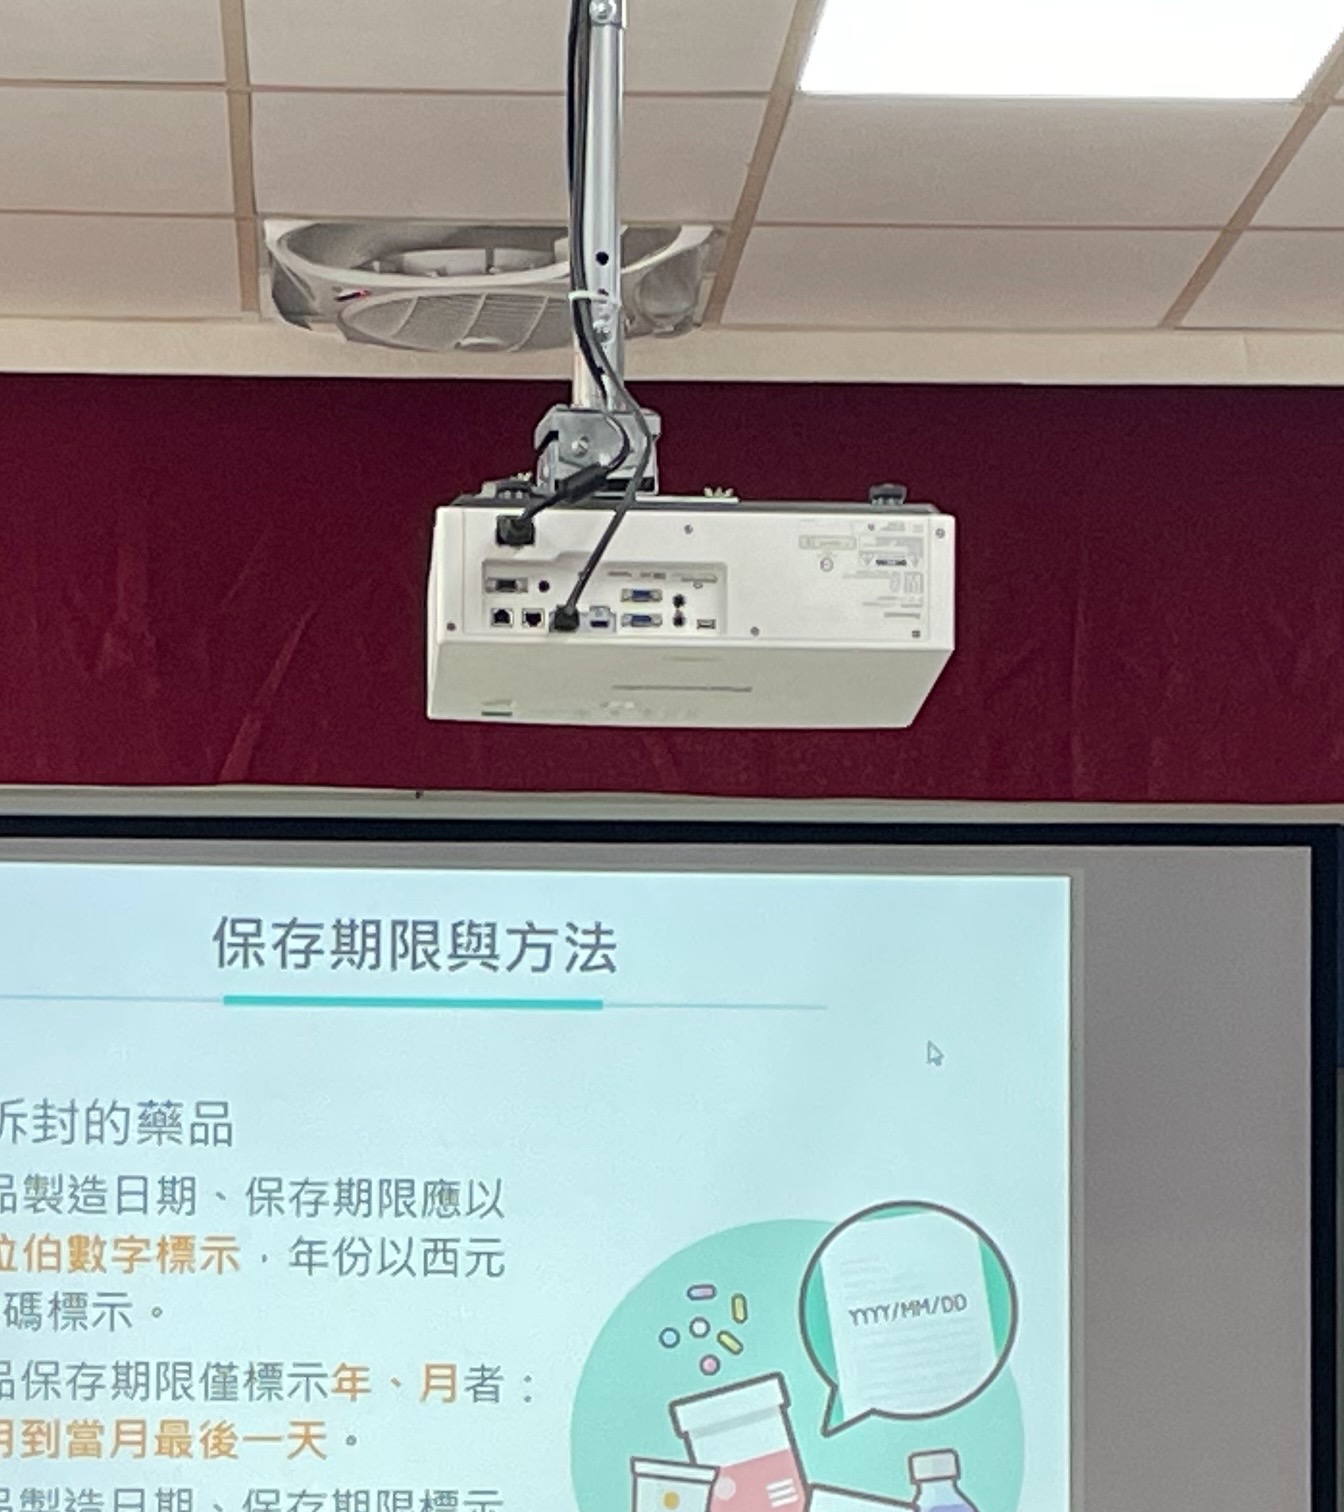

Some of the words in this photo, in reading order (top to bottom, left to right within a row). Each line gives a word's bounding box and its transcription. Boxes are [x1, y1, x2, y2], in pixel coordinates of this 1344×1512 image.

[212, 915, 618, 974] 保存期限與方法
[848, 1293, 968, 1326] YYYY/MM/DD
